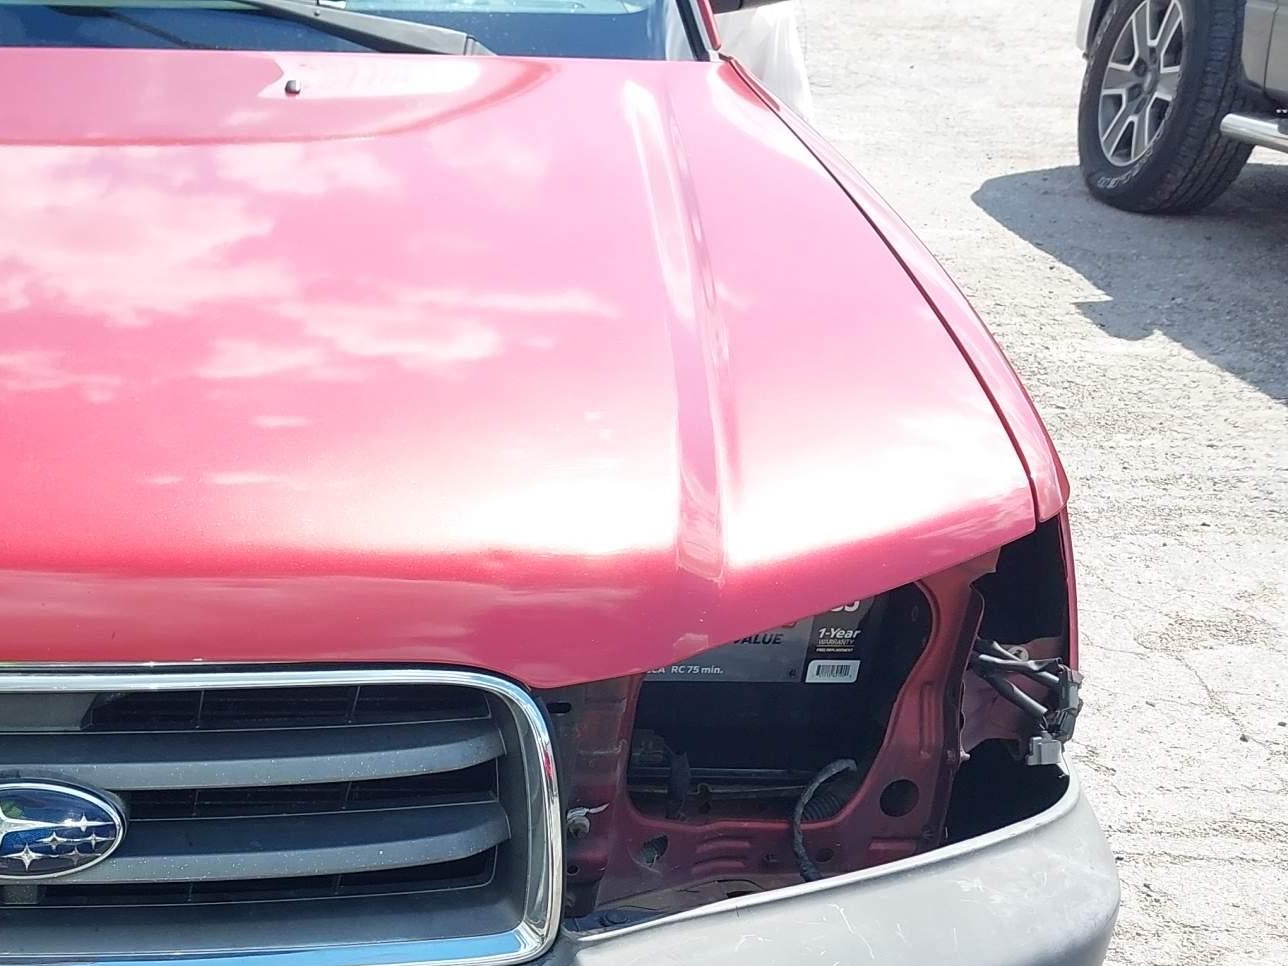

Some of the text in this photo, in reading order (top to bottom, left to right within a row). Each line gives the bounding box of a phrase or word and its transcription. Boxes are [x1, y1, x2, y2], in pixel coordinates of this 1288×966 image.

[733, 633, 784, 645] ALUE
[818, 627, 862, 639] 1-Year
[671, 665, 686, 674] RC
[686, 665, 700, 674] 75
[700, 665, 724, 674] min.
